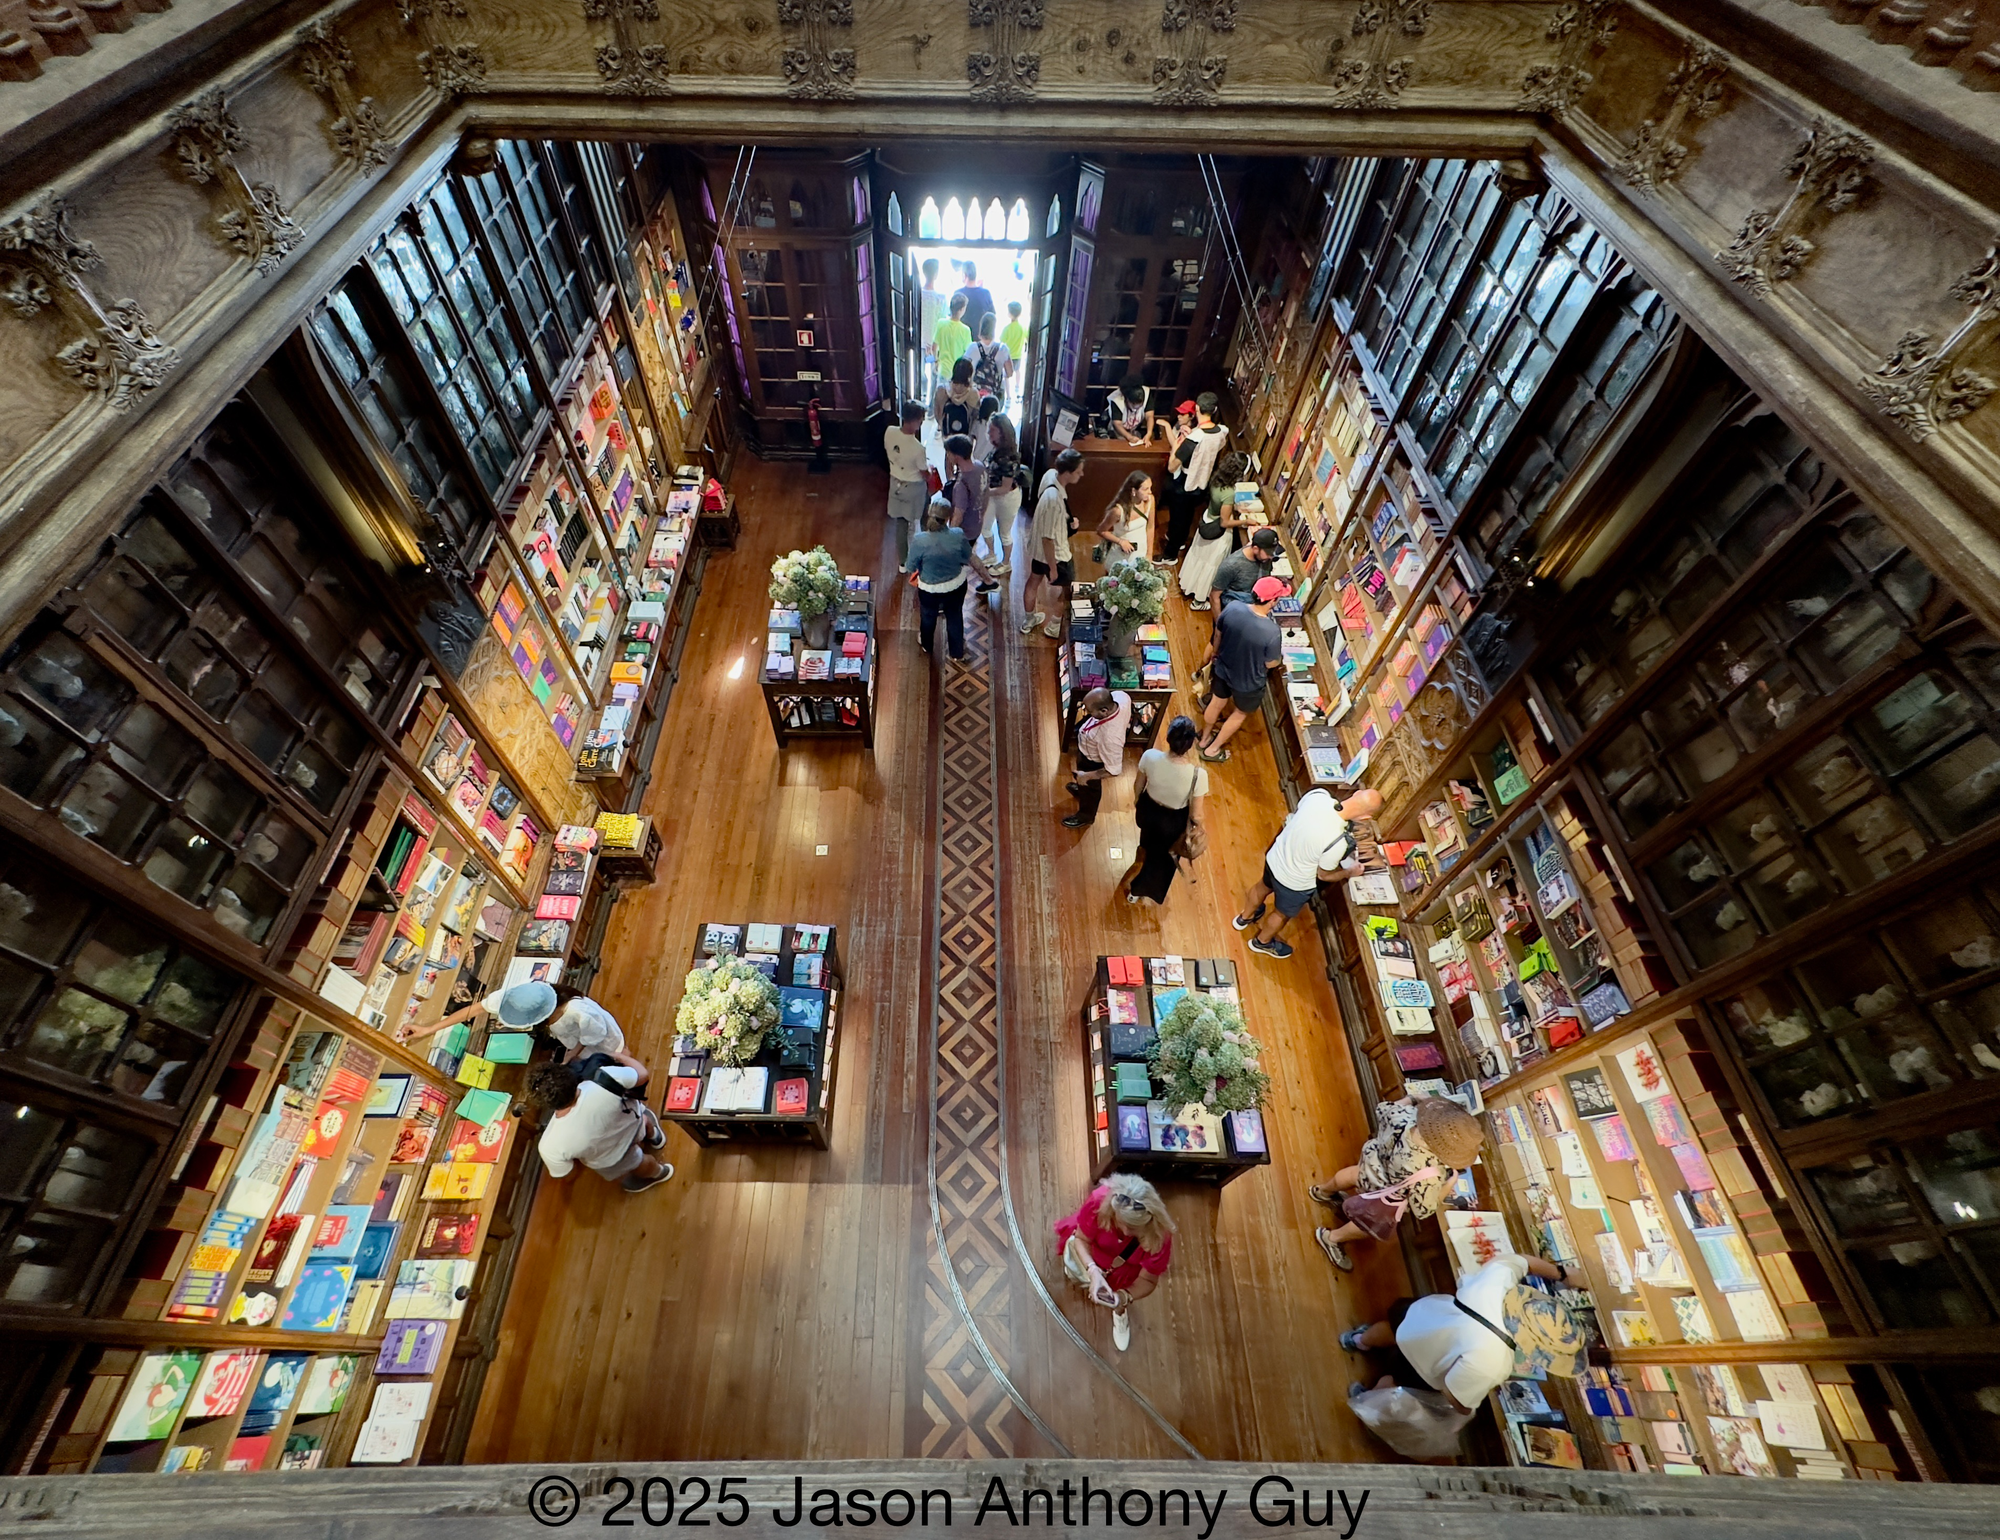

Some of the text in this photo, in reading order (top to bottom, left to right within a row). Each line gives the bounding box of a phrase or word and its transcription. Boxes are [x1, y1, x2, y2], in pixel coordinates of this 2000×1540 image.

[584, 729, 595, 746] John
[579, 750, 589, 766] John
[433, 933, 443, 954] PORTO
[1512, 1110, 1525, 1136] PORTO
[1537, 1100, 1552, 1125] PORTO
[1655, 1099, 1675, 1134] LIVRARIA
[1604, 1119, 1624, 1152] LIVRARIA
[1652, 1117, 1667, 1140] BOOK
[1600, 1136, 1615, 1158] BOOK
[1552, 1222, 1568, 1257] PORTUGAL
[1759, 1295, 1782, 1341] PORTUGA
[1722, 1369, 1740, 1408] PORTO
